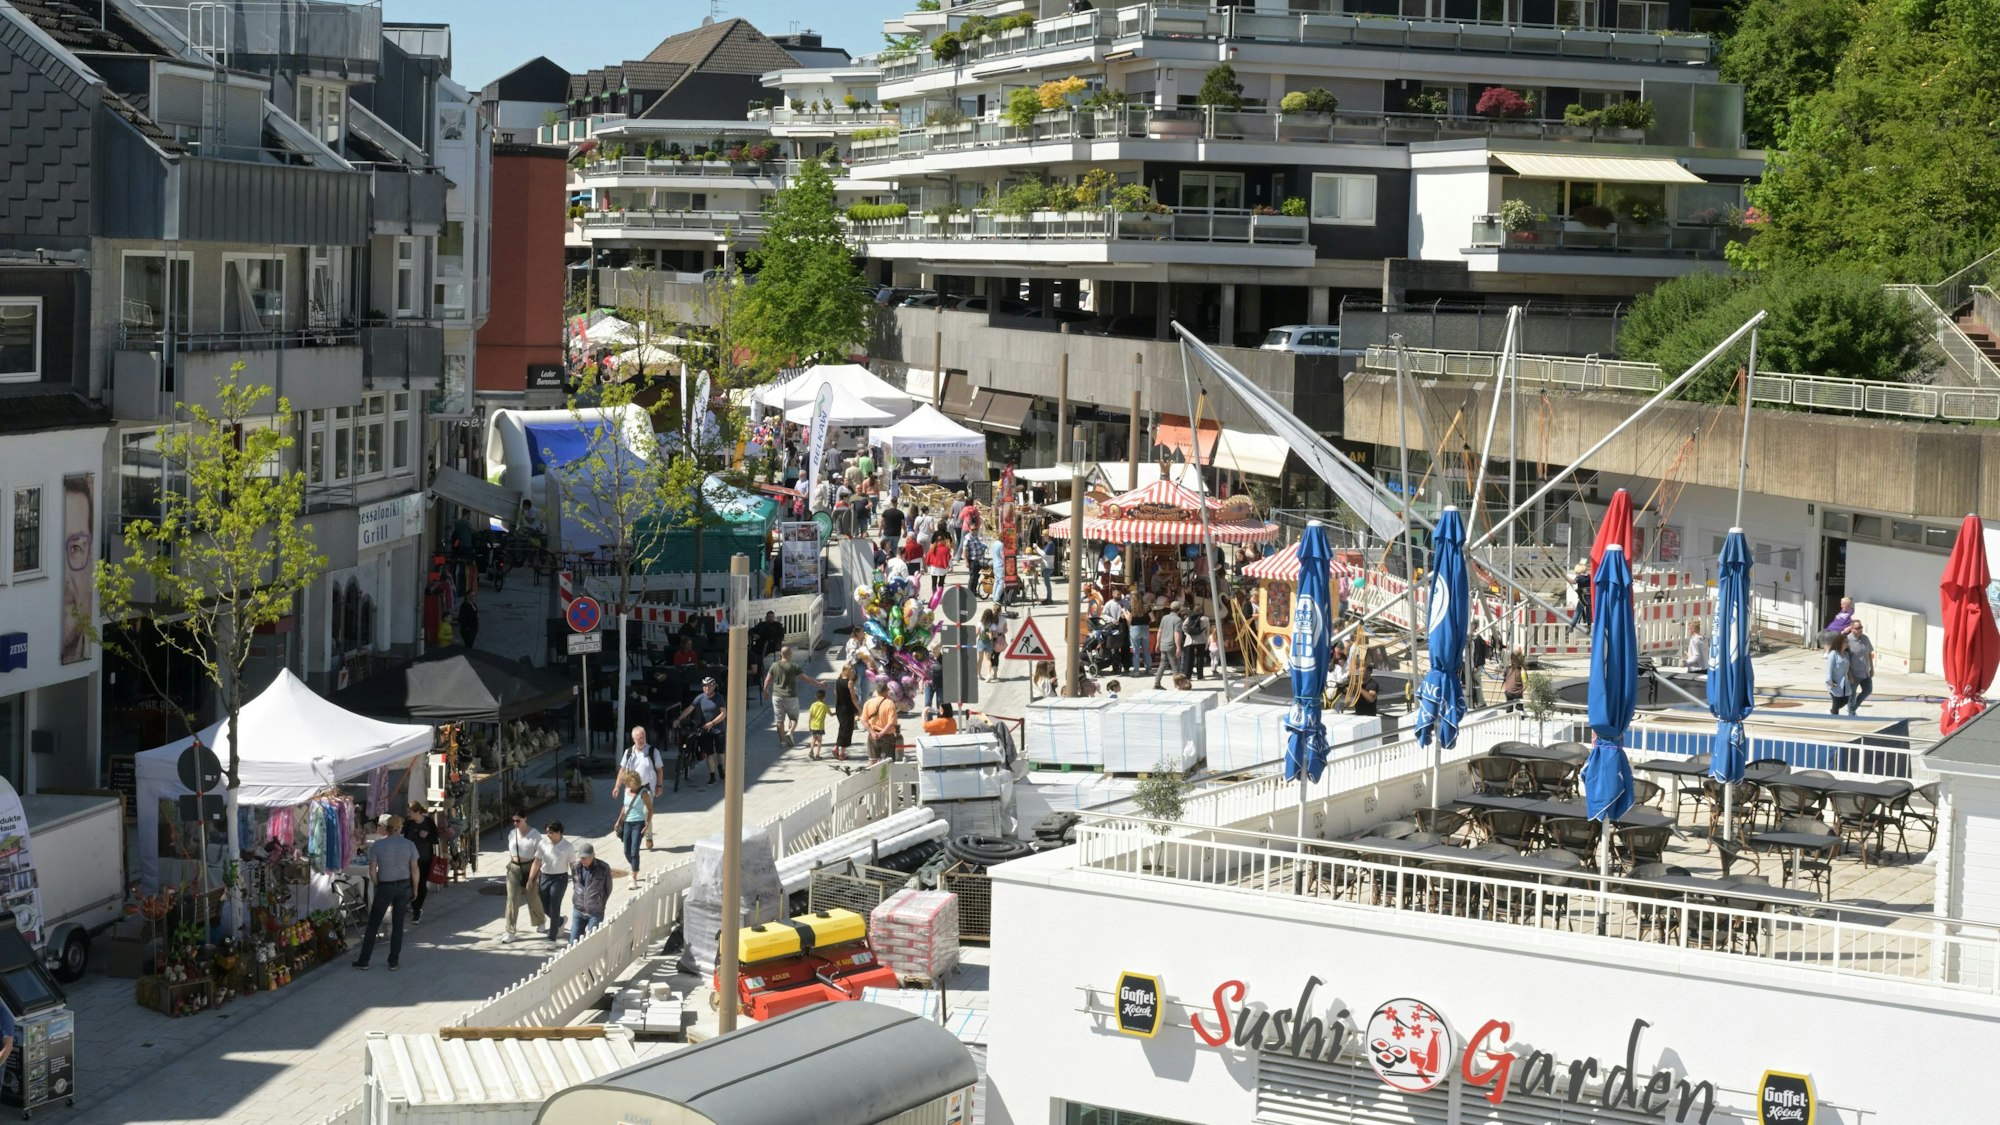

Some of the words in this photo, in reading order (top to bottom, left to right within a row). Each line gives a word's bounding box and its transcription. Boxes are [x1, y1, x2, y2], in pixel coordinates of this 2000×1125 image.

[813, 410, 828, 466] BELKAW
[363, 524, 388, 544] Grill
[771, 972, 791, 982] ADLER
[1190, 975, 1350, 1063] Sushi
[1461, 1018, 1715, 1125] Garden
